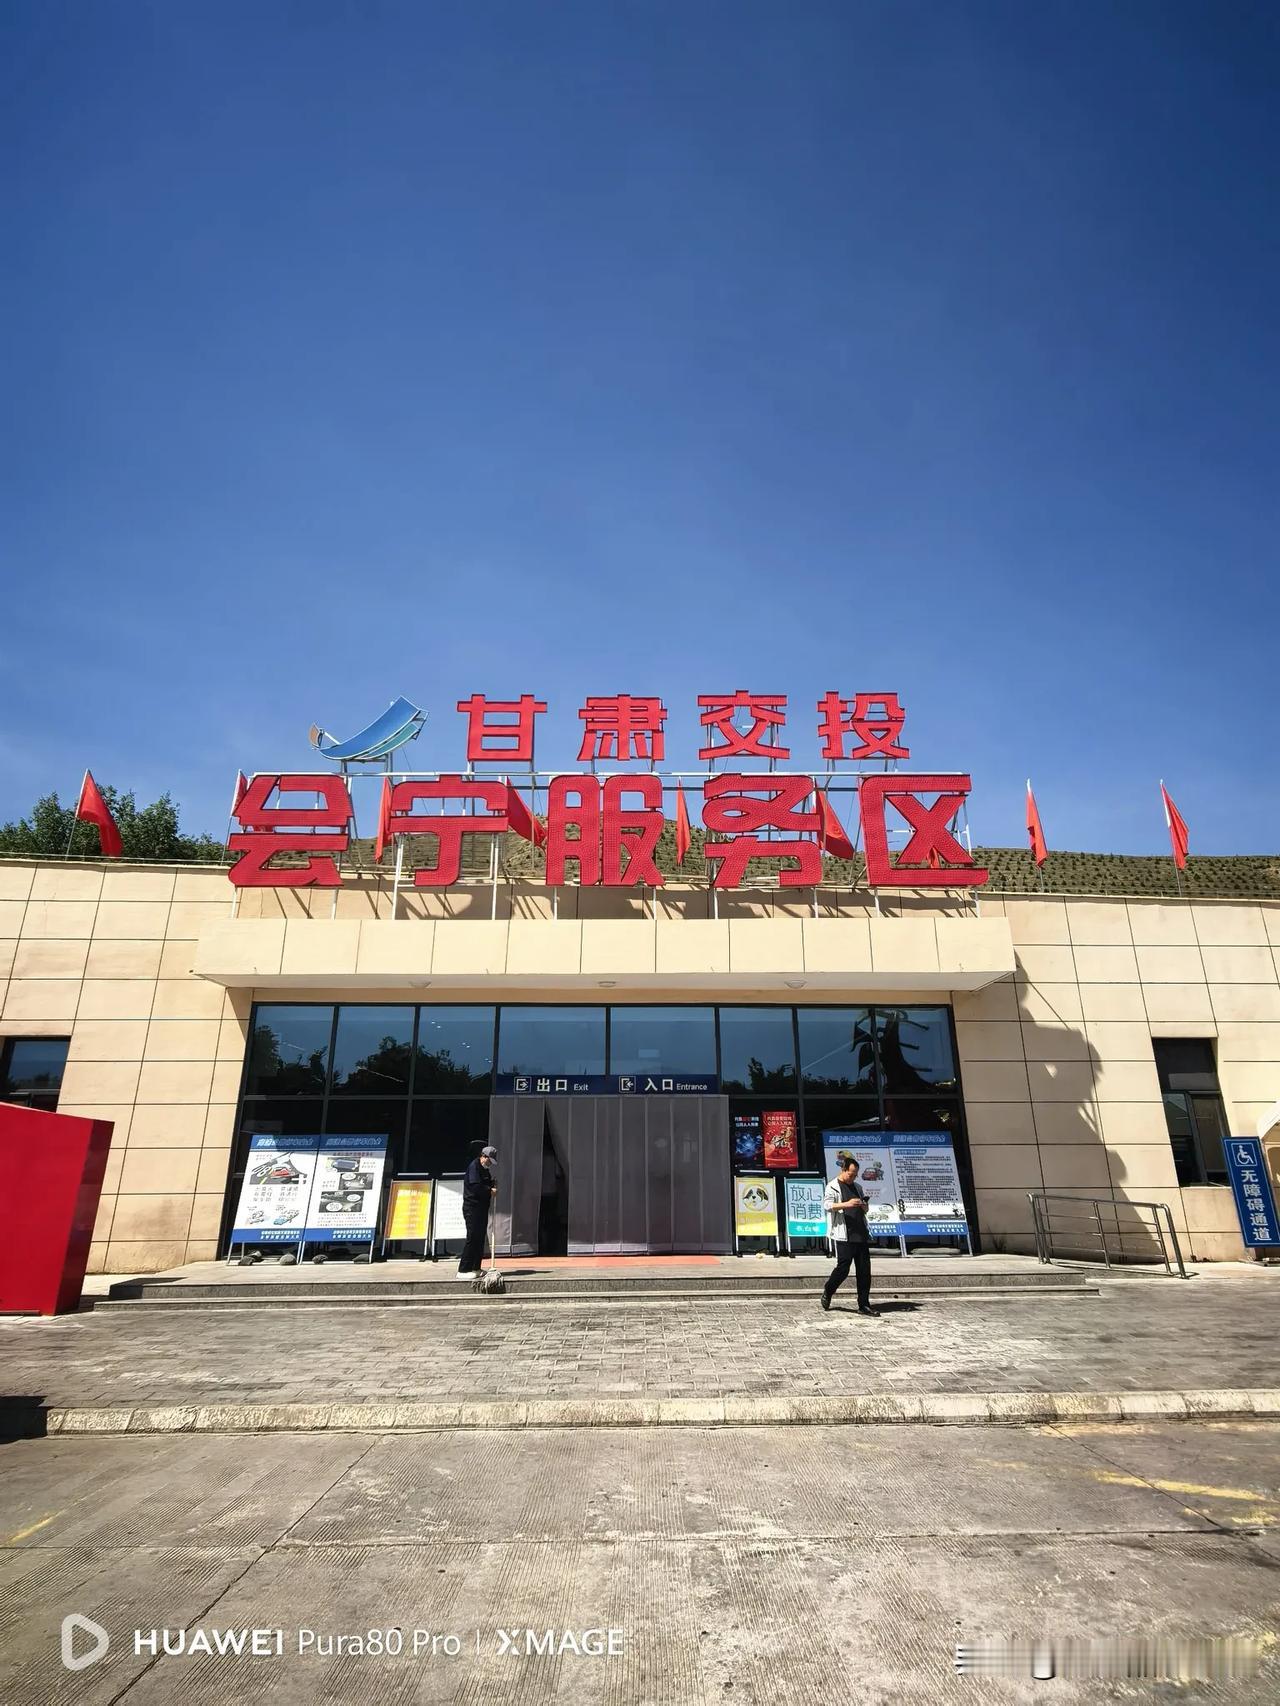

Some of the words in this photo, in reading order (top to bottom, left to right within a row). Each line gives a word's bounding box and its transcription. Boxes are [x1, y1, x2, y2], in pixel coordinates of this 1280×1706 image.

[456, 689, 910, 761] 甘肃交投
[228, 773, 988, 888] 会宁服务区
[537, 1078, 568, 1092] 出口
[573, 1083, 589, 1091] Exit
[645, 1078, 673, 1092] 入口
[676, 1083, 708, 1091] Entrance
[790, 1185, 823, 1202] 放心
[791, 1203, 823, 1220] 消费
[1241, 1170, 1272, 1241] 无障碍通道
